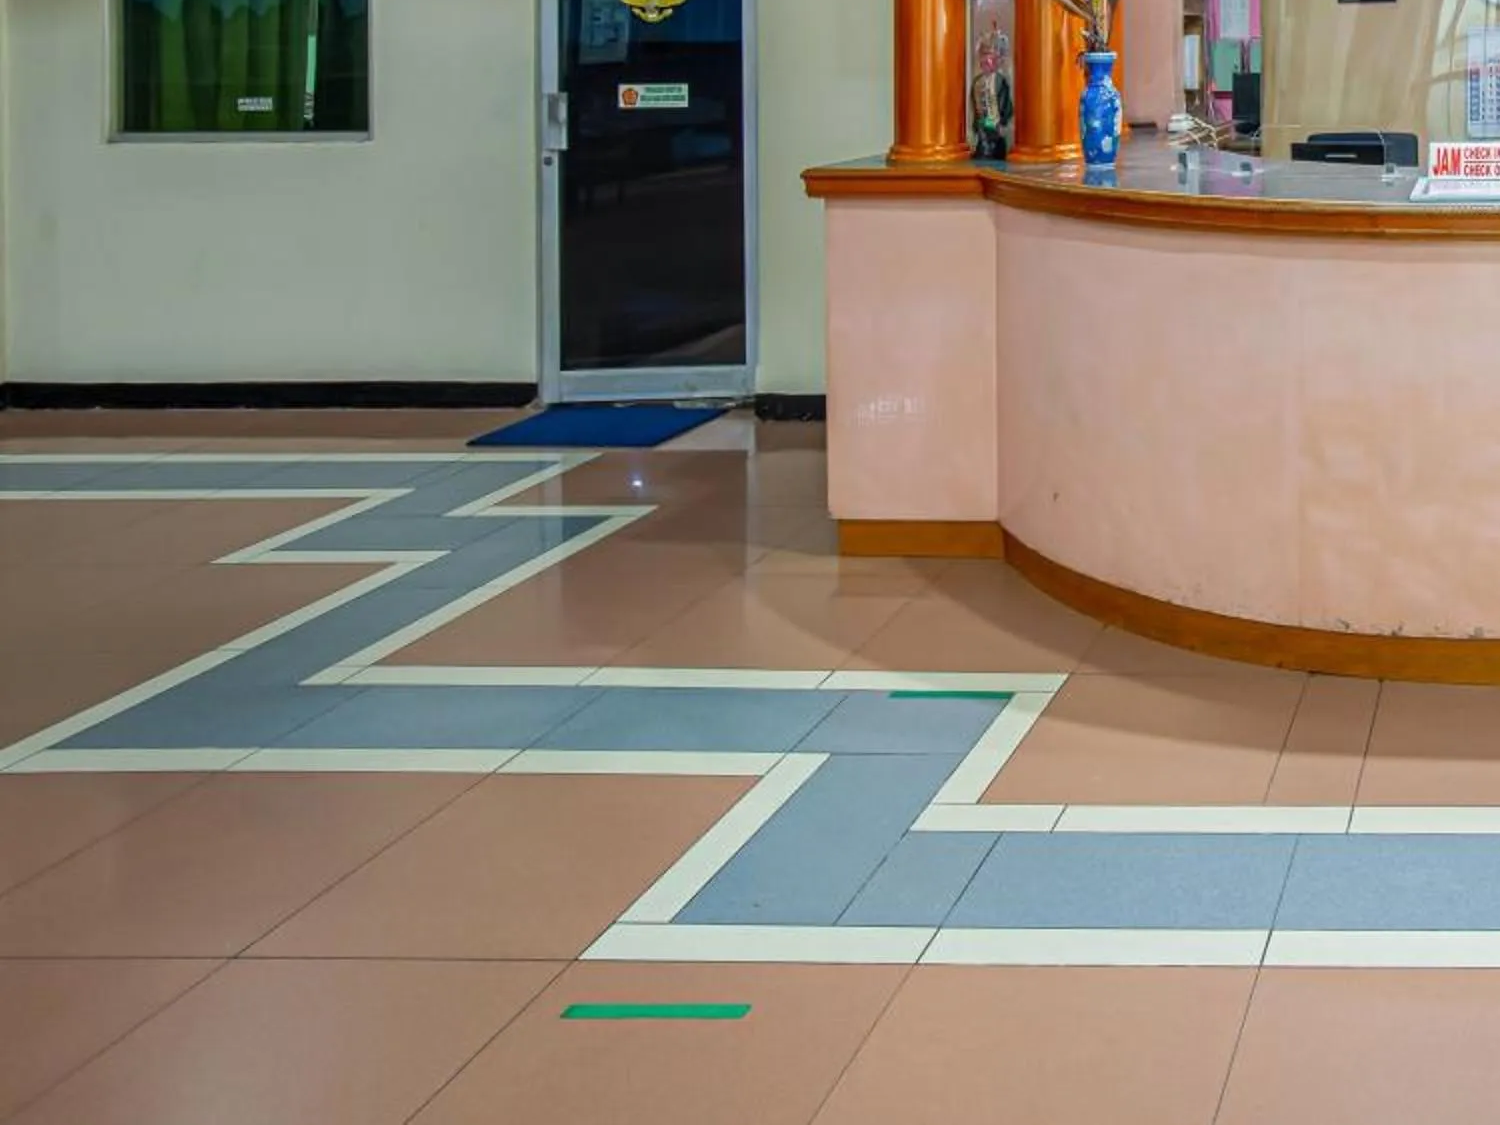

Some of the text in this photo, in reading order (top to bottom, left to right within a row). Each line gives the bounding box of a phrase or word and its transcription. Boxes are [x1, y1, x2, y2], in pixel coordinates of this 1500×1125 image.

[1464, 147, 1490, 159] CHECK
[1433, 147, 1461, 176] JAM
[1464, 165, 1491, 177] CHECK
